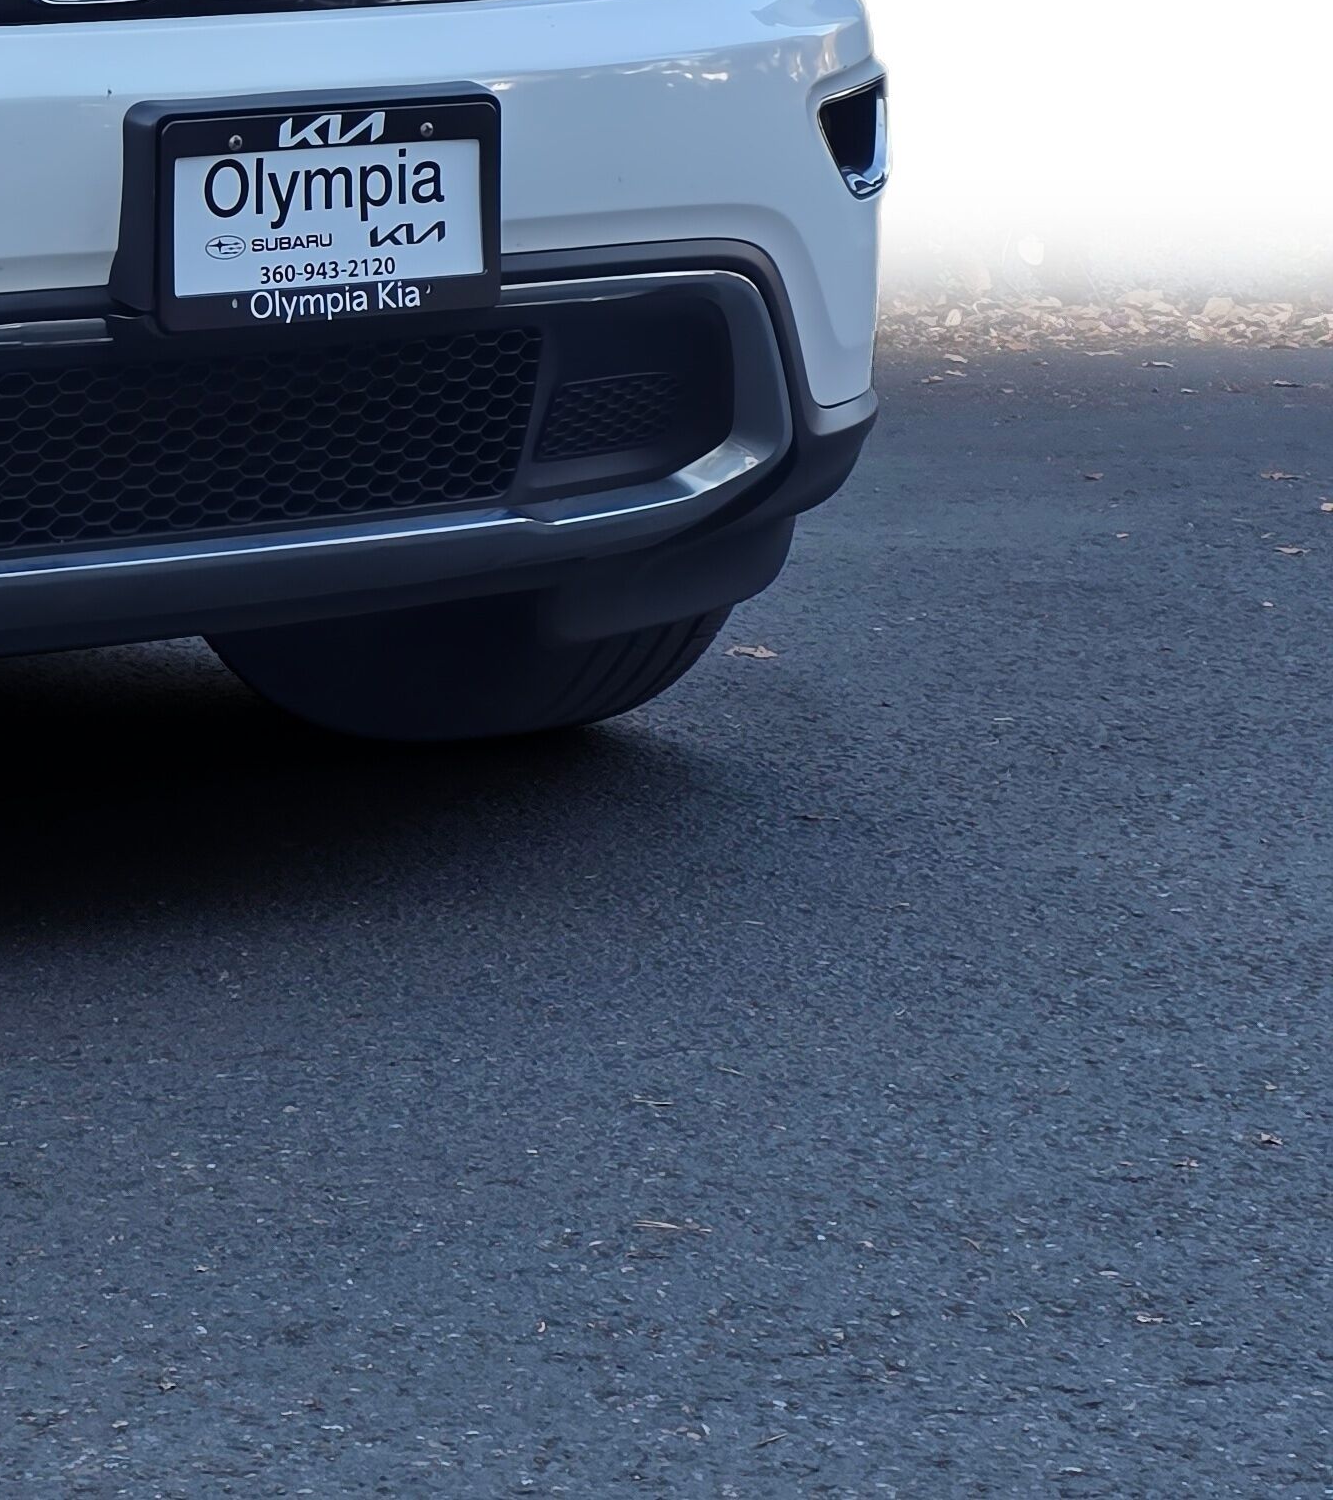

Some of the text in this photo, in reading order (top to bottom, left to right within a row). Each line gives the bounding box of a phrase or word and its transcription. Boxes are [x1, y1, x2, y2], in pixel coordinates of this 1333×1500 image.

[204, 148, 445, 229] Olympia
[251, 233, 333, 253] SUBARU
[259, 256, 396, 285] 360-943-2120
[250, 280, 421, 324] Olympia Kia
